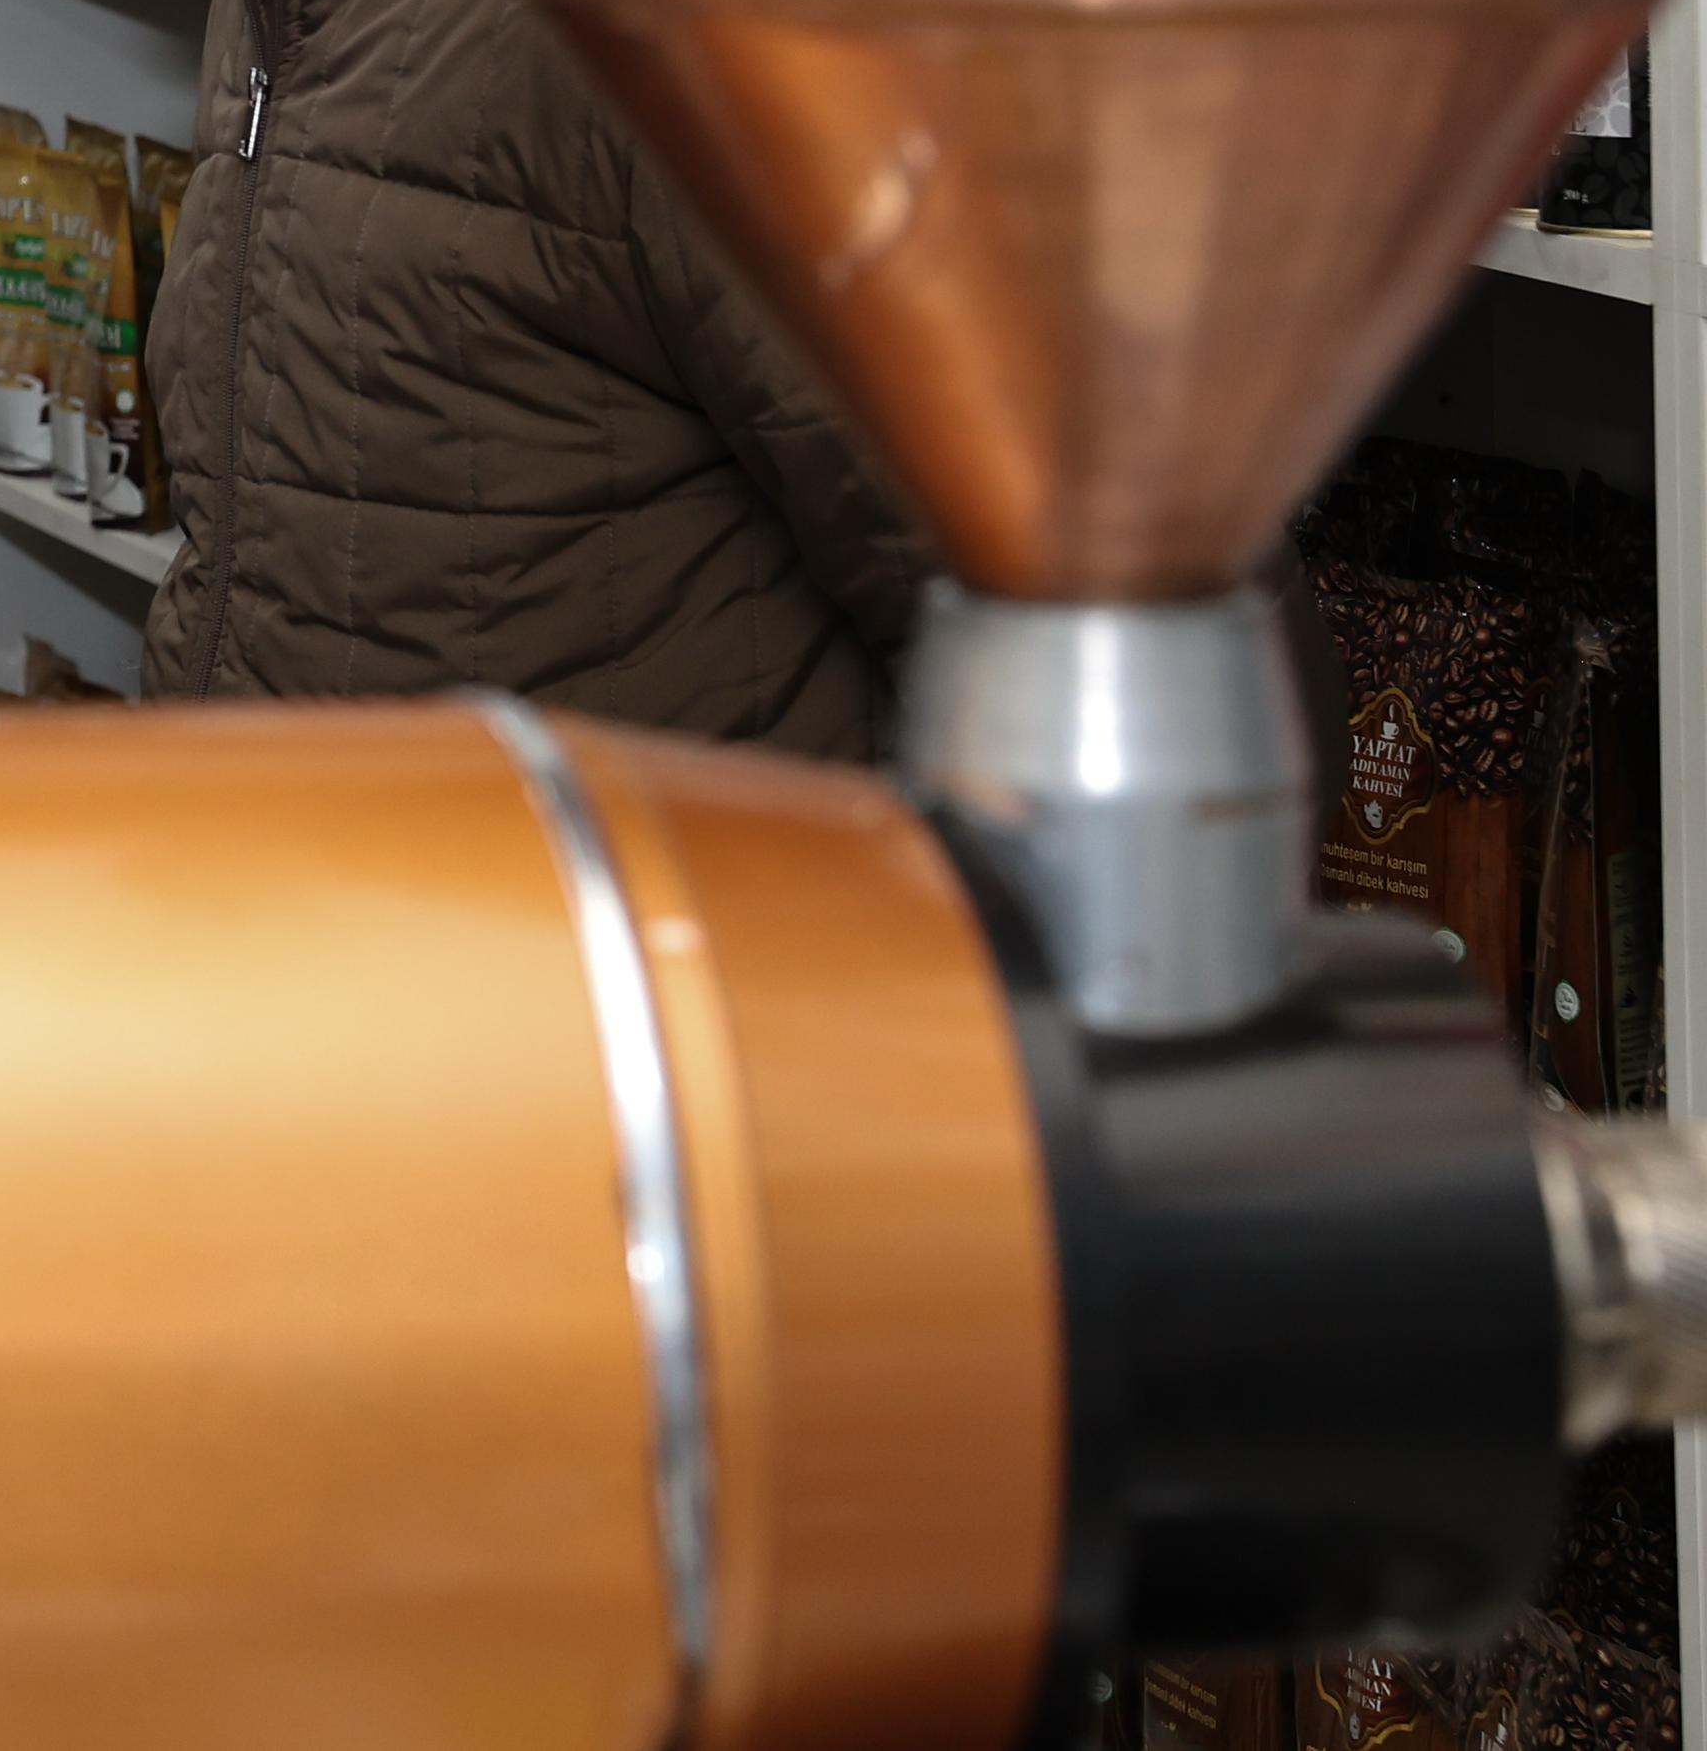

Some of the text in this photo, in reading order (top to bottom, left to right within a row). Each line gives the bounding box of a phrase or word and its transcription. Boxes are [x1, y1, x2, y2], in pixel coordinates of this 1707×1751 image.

[1352, 734, 1416, 765] YAPTAT
[1349, 758, 1411, 781] ADIYAMAN
[1352, 775, 1403, 798] KAHVESİ
[1370, 850, 1385, 866] bir
[1386, 853, 1427, 876] karışım
[1356, 872, 1385, 890] dibek
[1386, 875, 1429, 900] kahvesi
